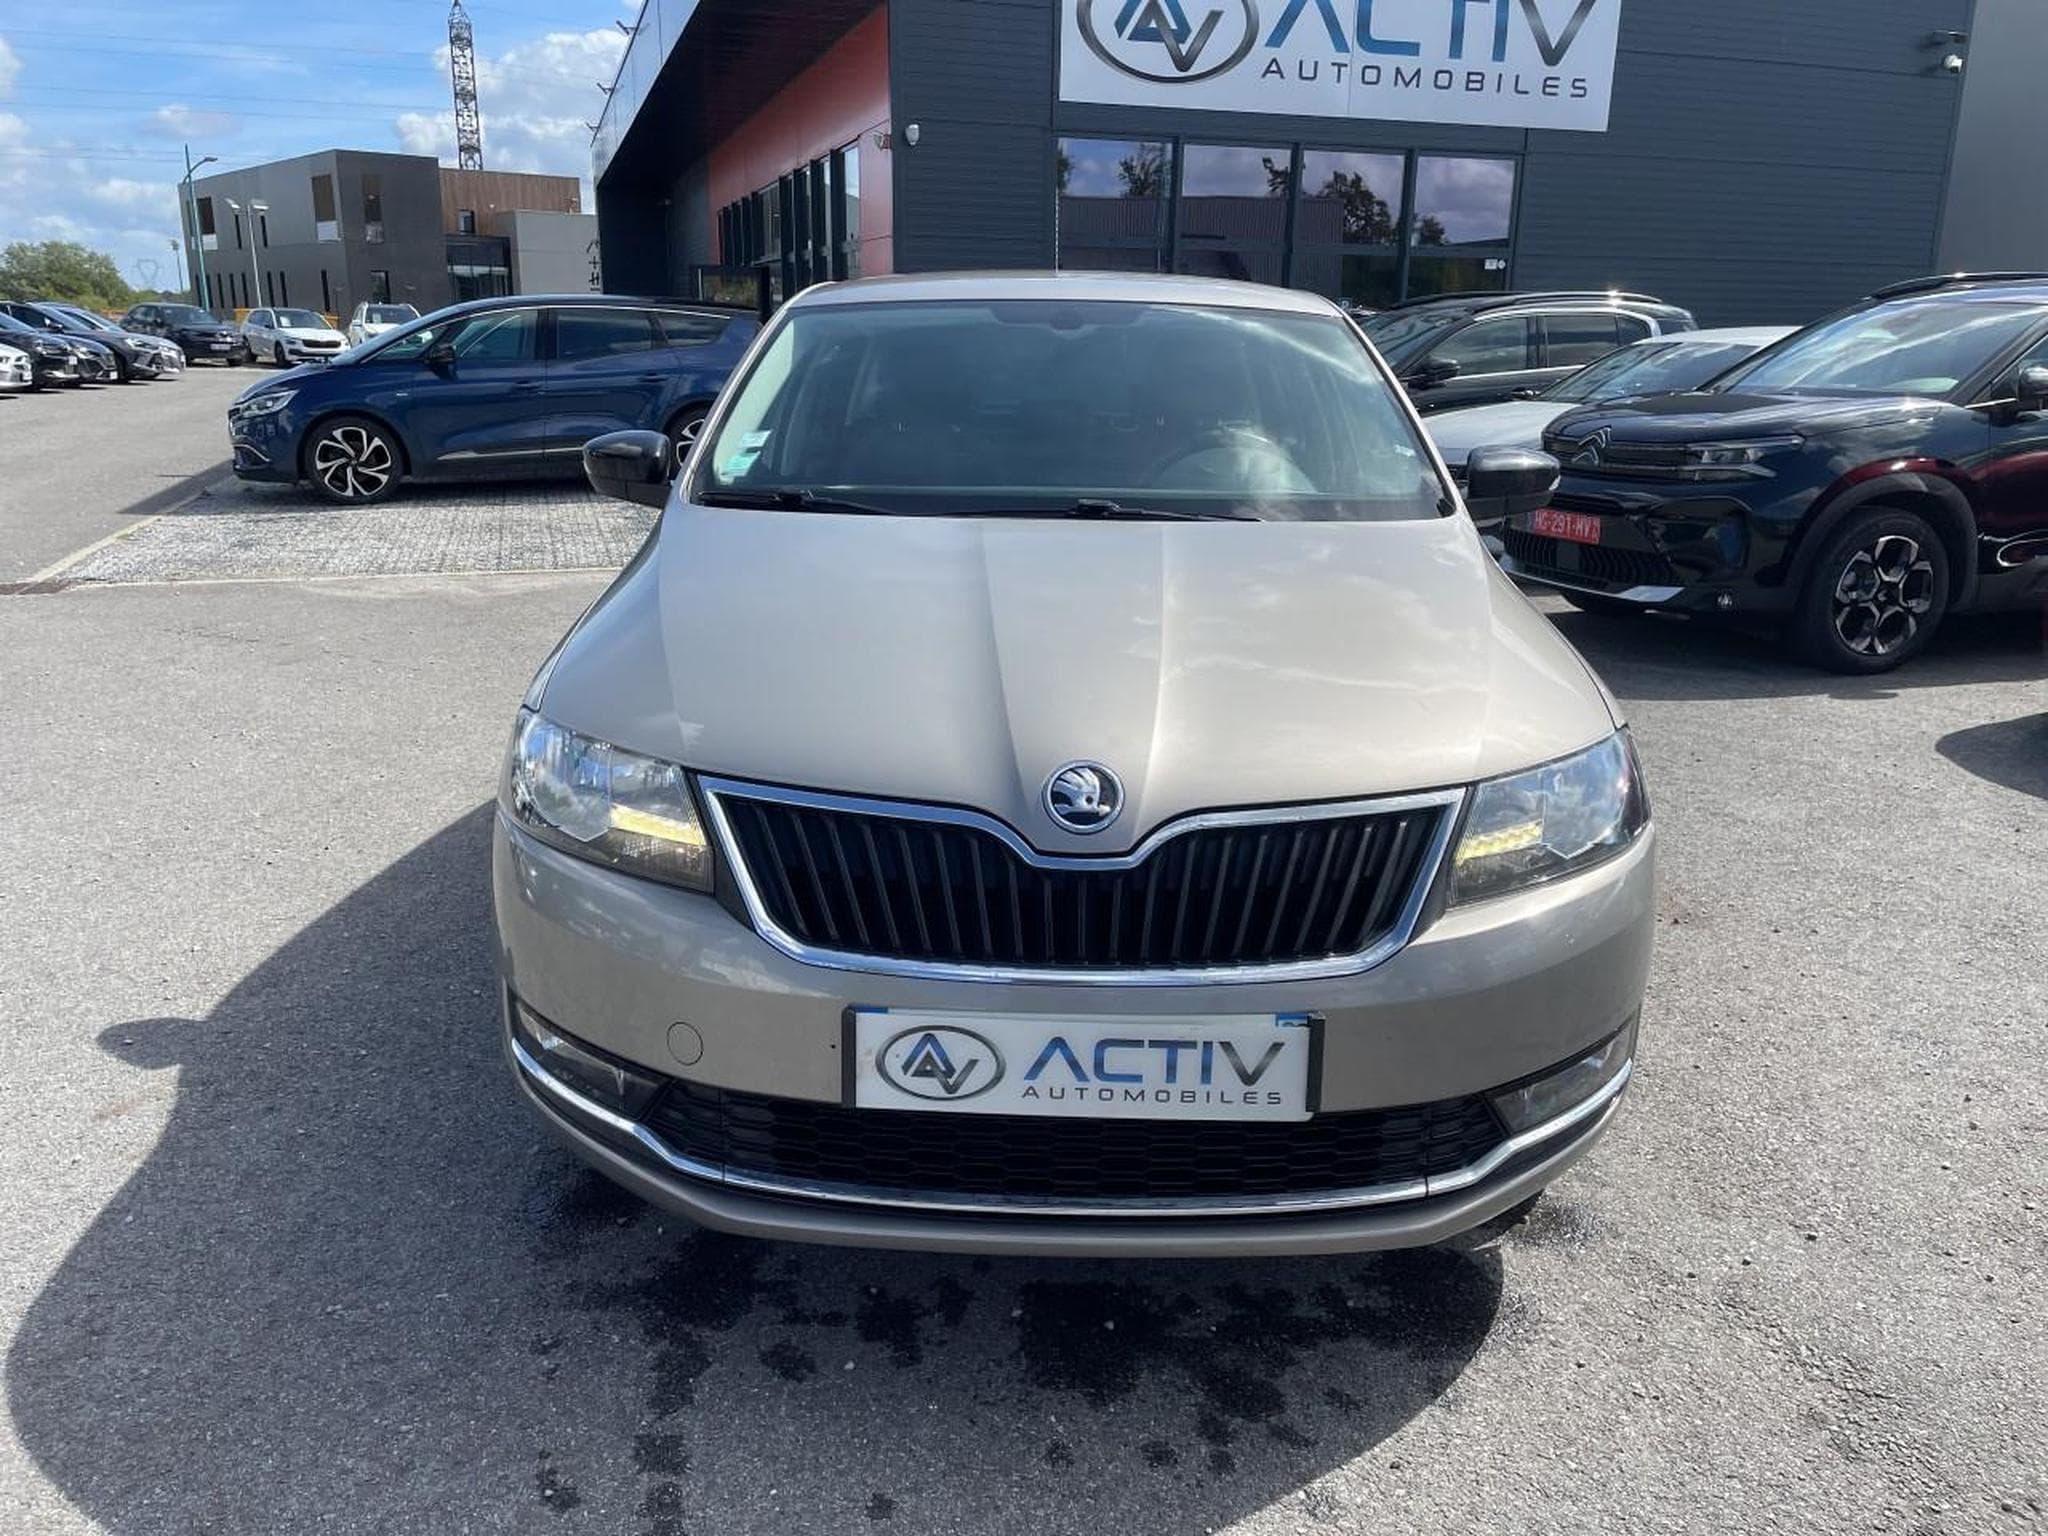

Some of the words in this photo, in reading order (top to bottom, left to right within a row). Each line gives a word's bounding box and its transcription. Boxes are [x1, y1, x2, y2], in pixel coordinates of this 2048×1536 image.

[1261, 57, 1588, 98] AUTOMOBILES
[1023, 1036, 1285, 1087] ACTIV
[1022, 1086, 1282, 1106] AUTOMOBILES
